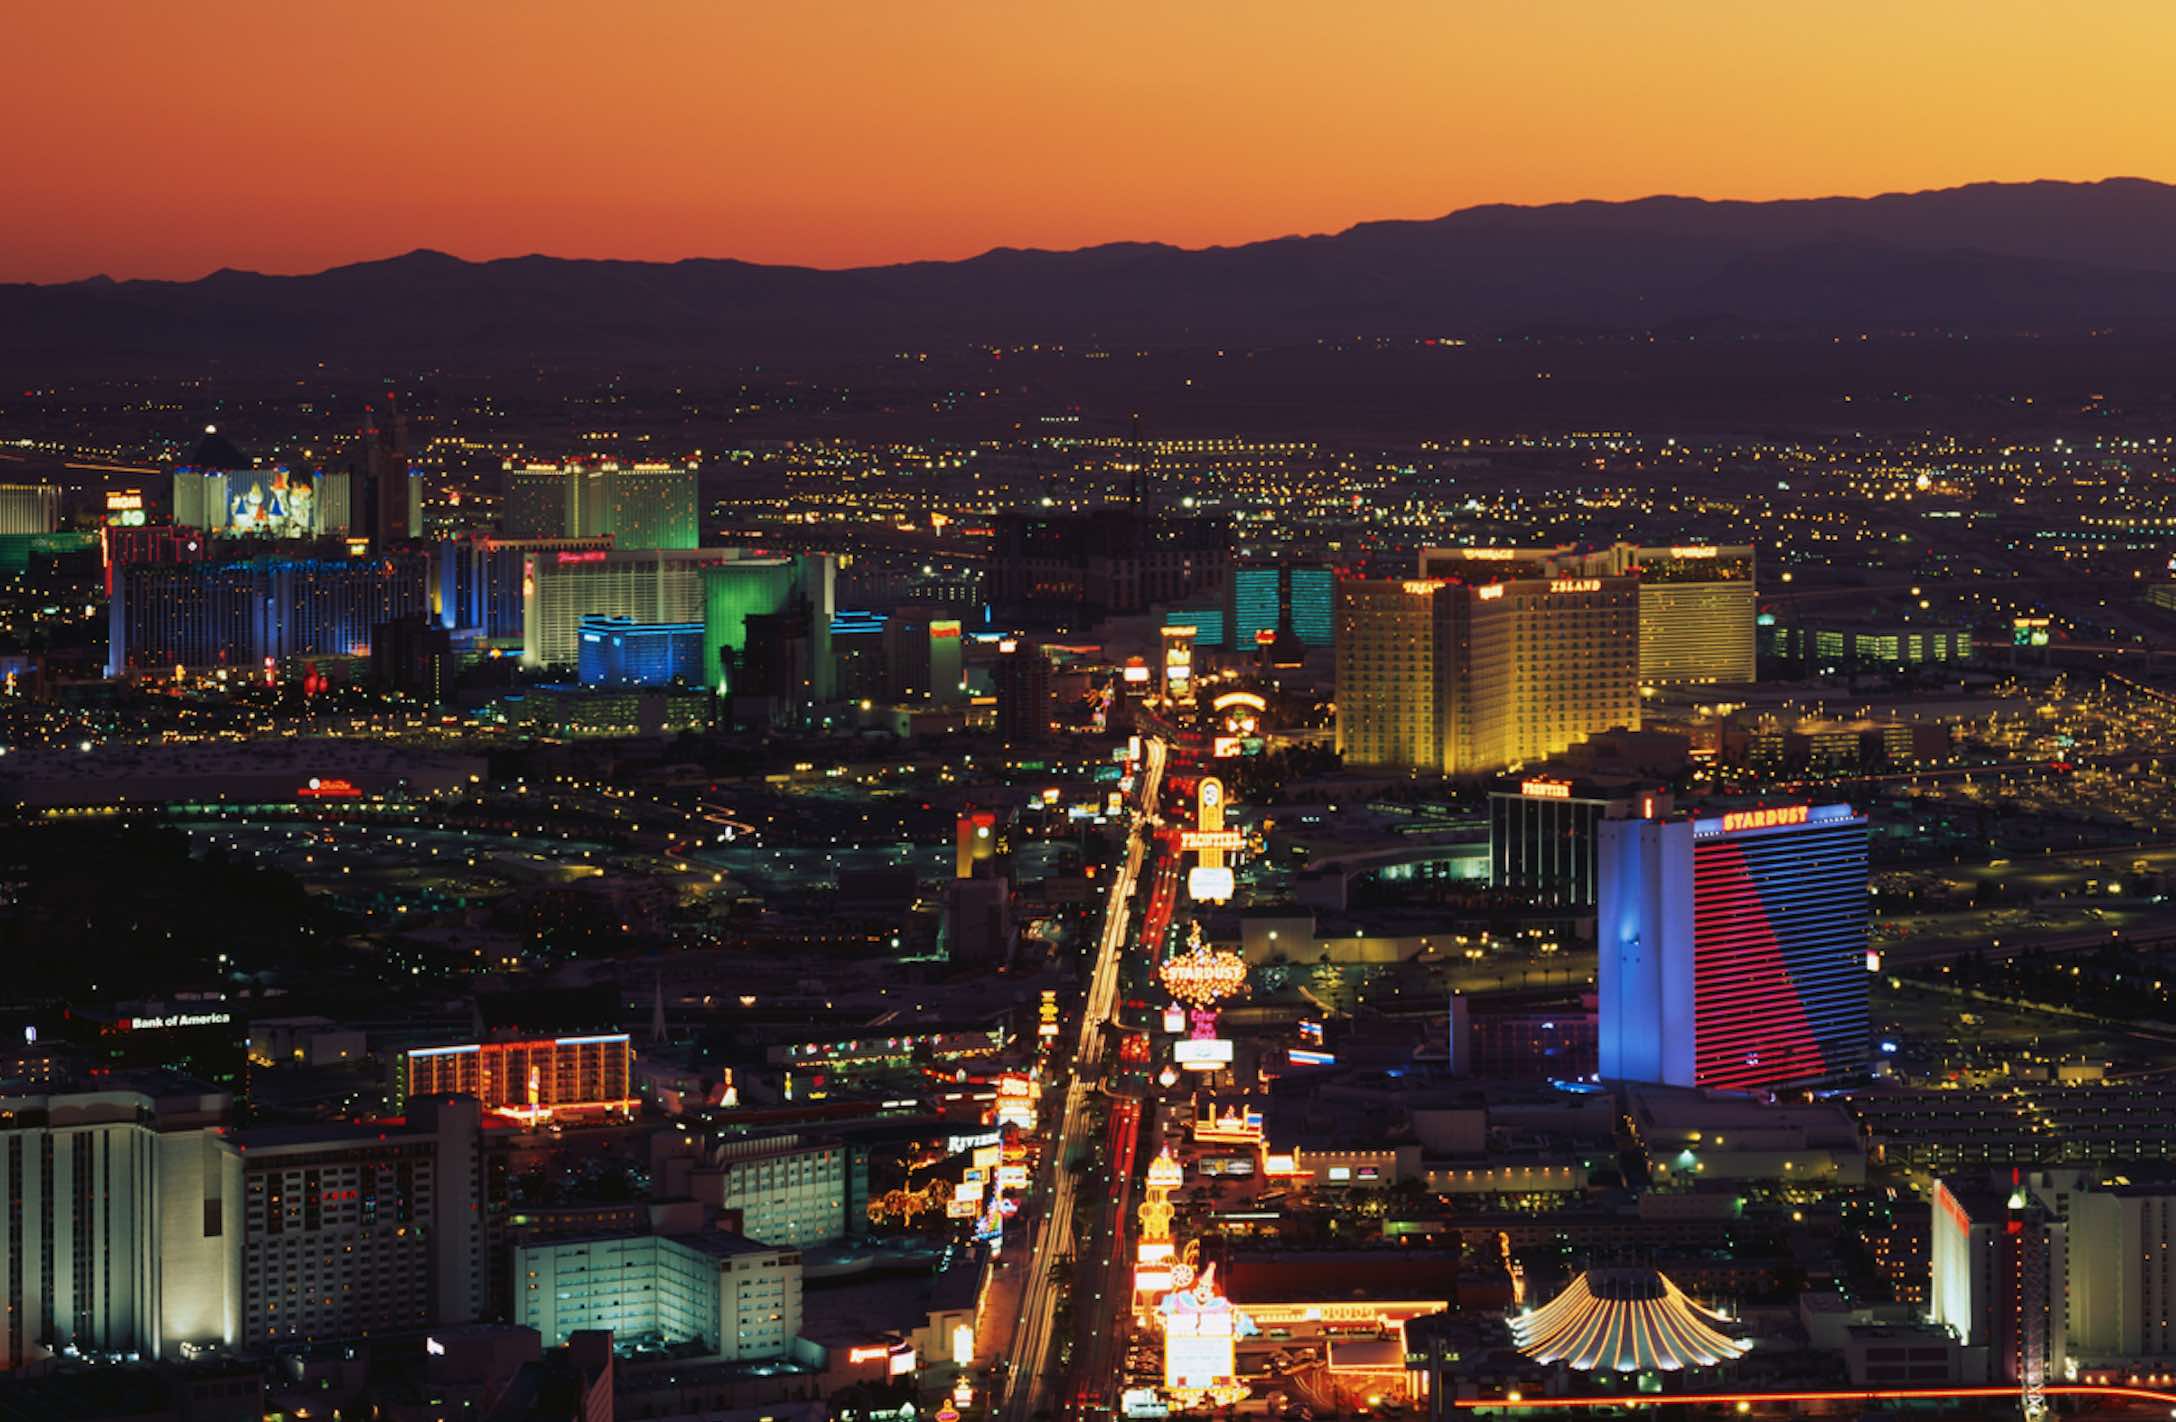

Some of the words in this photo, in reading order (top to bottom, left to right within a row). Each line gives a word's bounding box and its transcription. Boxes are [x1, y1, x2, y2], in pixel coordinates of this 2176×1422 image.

[1550, 580, 1600, 592] ISLAND
[1724, 806, 1807, 831] STARDUST
[1181, 832, 1240, 848] FRONTIER
[1168, 966, 1241, 980] STARDUST
[132, 1017, 163, 1029] Bank
[164, 1016, 178, 1026] of
[179, 1012, 230, 1026] America
